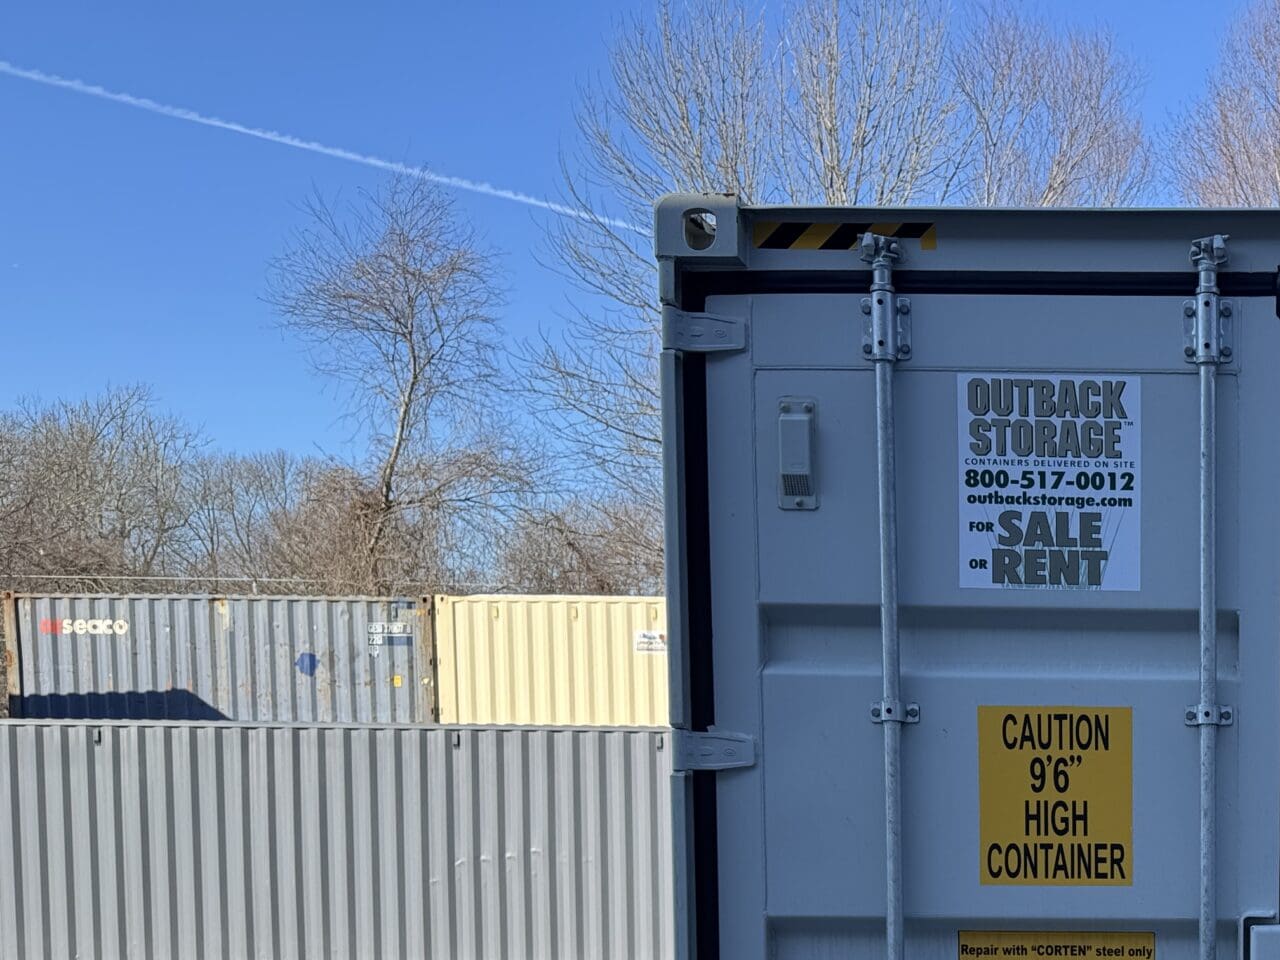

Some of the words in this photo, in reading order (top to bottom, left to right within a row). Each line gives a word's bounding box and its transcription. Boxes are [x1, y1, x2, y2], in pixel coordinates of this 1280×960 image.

[967, 377, 1128, 419] OUTBACK
[968, 418, 1123, 459] STORAGE
[964, 457, 1029, 467] CONTAINERS
[1033, 459, 1090, 468] DELIVERED
[1094, 460, 1109, 469] ON
[1113, 460, 1135, 469] SITE
[965, 469, 1135, 491] 800-517-0012
[966, 491, 1133, 509] outbackstorage.com
[969, 521, 994, 532] FOR
[997, 510, 1102, 548] SALE
[969, 558, 988, 570] OR
[991, 548, 1108, 586] RENT
[62, 618, 129, 636] seaco
[1002, 713, 1109, 751] CAUTION
[1024, 800, 1088, 836] HIGH
[987, 843, 1126, 879] CONTAINER
[961, 944, 998, 957] Repair
[1002, 945, 1027, 956] with
[1096, 946, 1124, 957] steel
[1128, 946, 1153, 960] only
